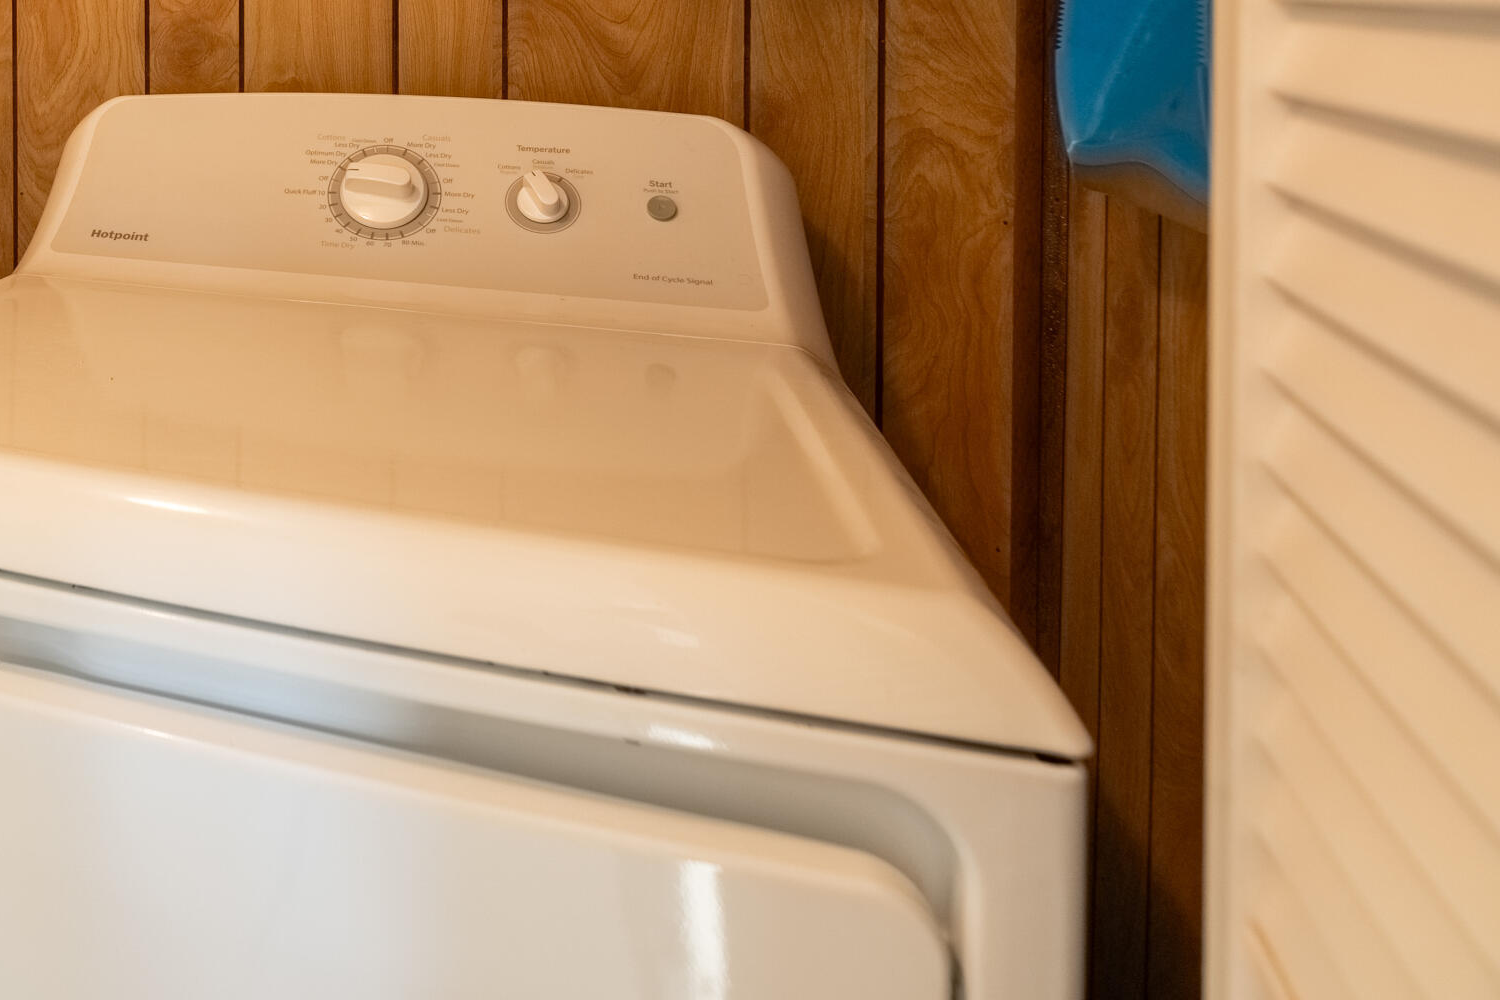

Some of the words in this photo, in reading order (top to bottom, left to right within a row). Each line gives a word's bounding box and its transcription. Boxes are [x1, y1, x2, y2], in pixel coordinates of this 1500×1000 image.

[383, 136, 394, 144] Off
[422, 134, 451, 142] Casuals
[347, 142, 360, 150] Dry
[516, 144, 571, 154] Temperature
[305, 149, 335, 158] Optimum
[326, 159, 338, 167] Dry
[565, 167, 594, 176] Delicates
[649, 180, 673, 189] Start
[461, 191, 475, 199] Dry
[456, 208, 469, 216] Dry
[444, 226, 481, 234] Delicates
[91, 229, 149, 241] Hotpoint
[321, 240, 341, 248] Time
[342, 242, 356, 250] Dry
[633, 273, 649, 281] End
[662, 275, 685, 284] Cycle
[687, 277, 713, 286] Signal
